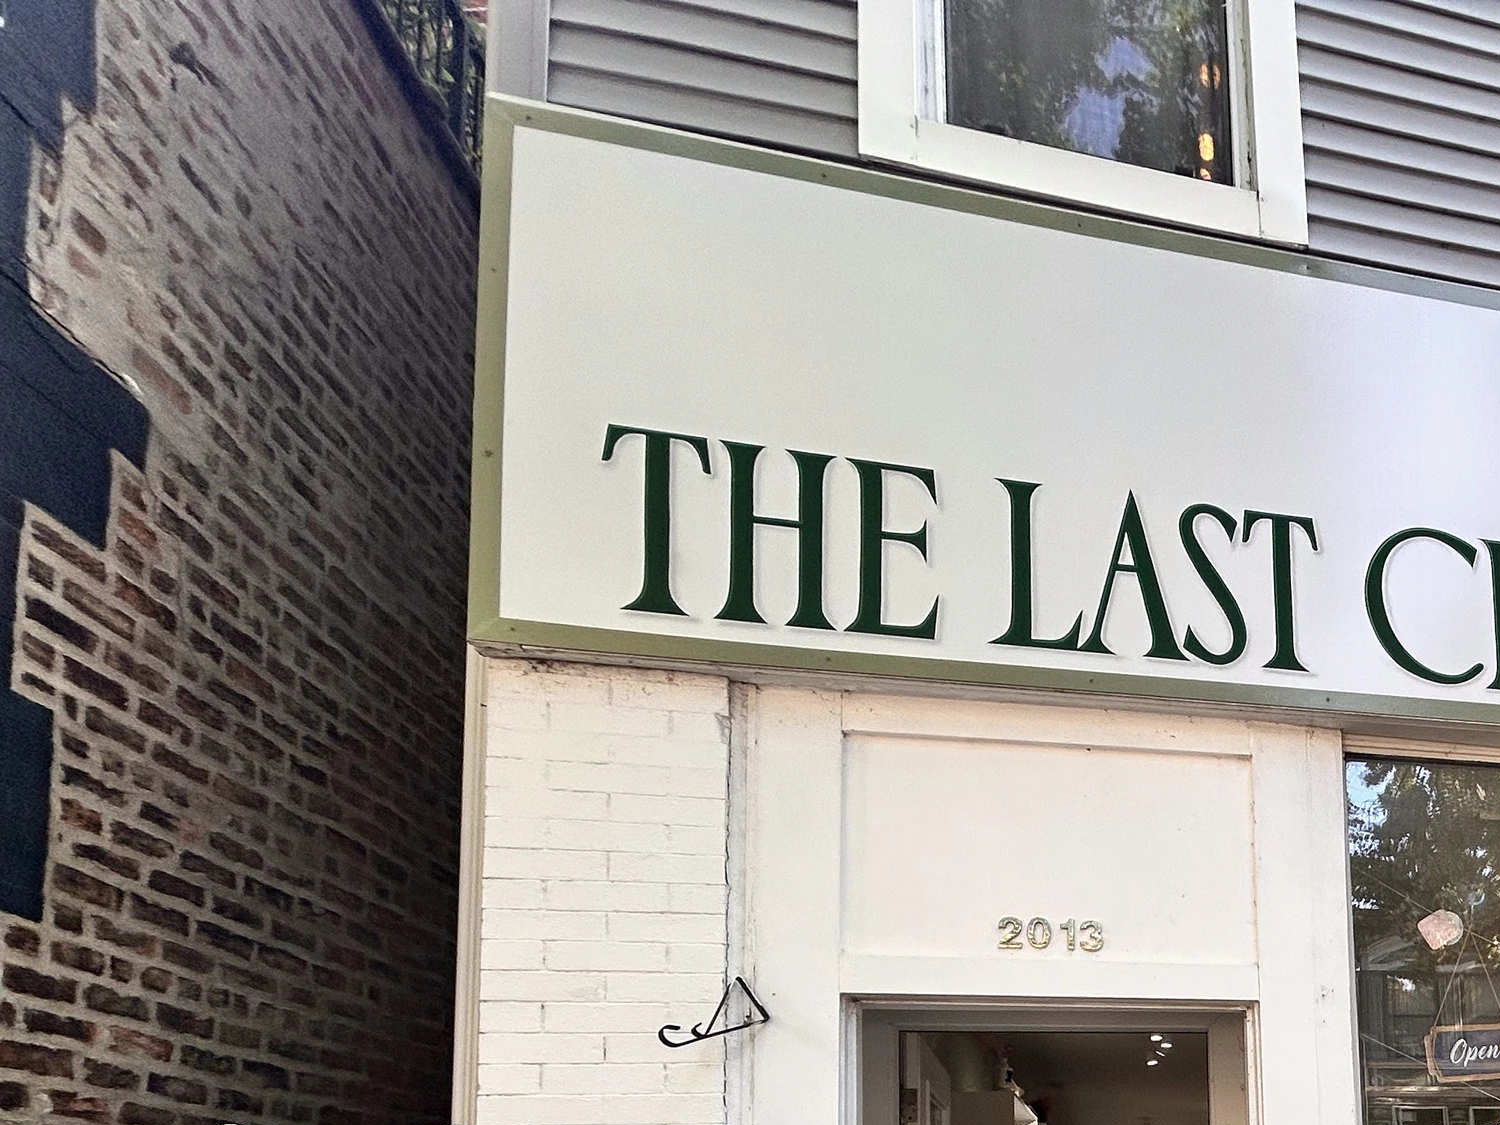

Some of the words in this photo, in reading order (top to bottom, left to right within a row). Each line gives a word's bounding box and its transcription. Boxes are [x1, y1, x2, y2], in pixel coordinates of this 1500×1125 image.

[602, 424, 938, 639] THE
[987, 477, 1318, 672] LAST
[997, 916, 1104, 952] 2013
